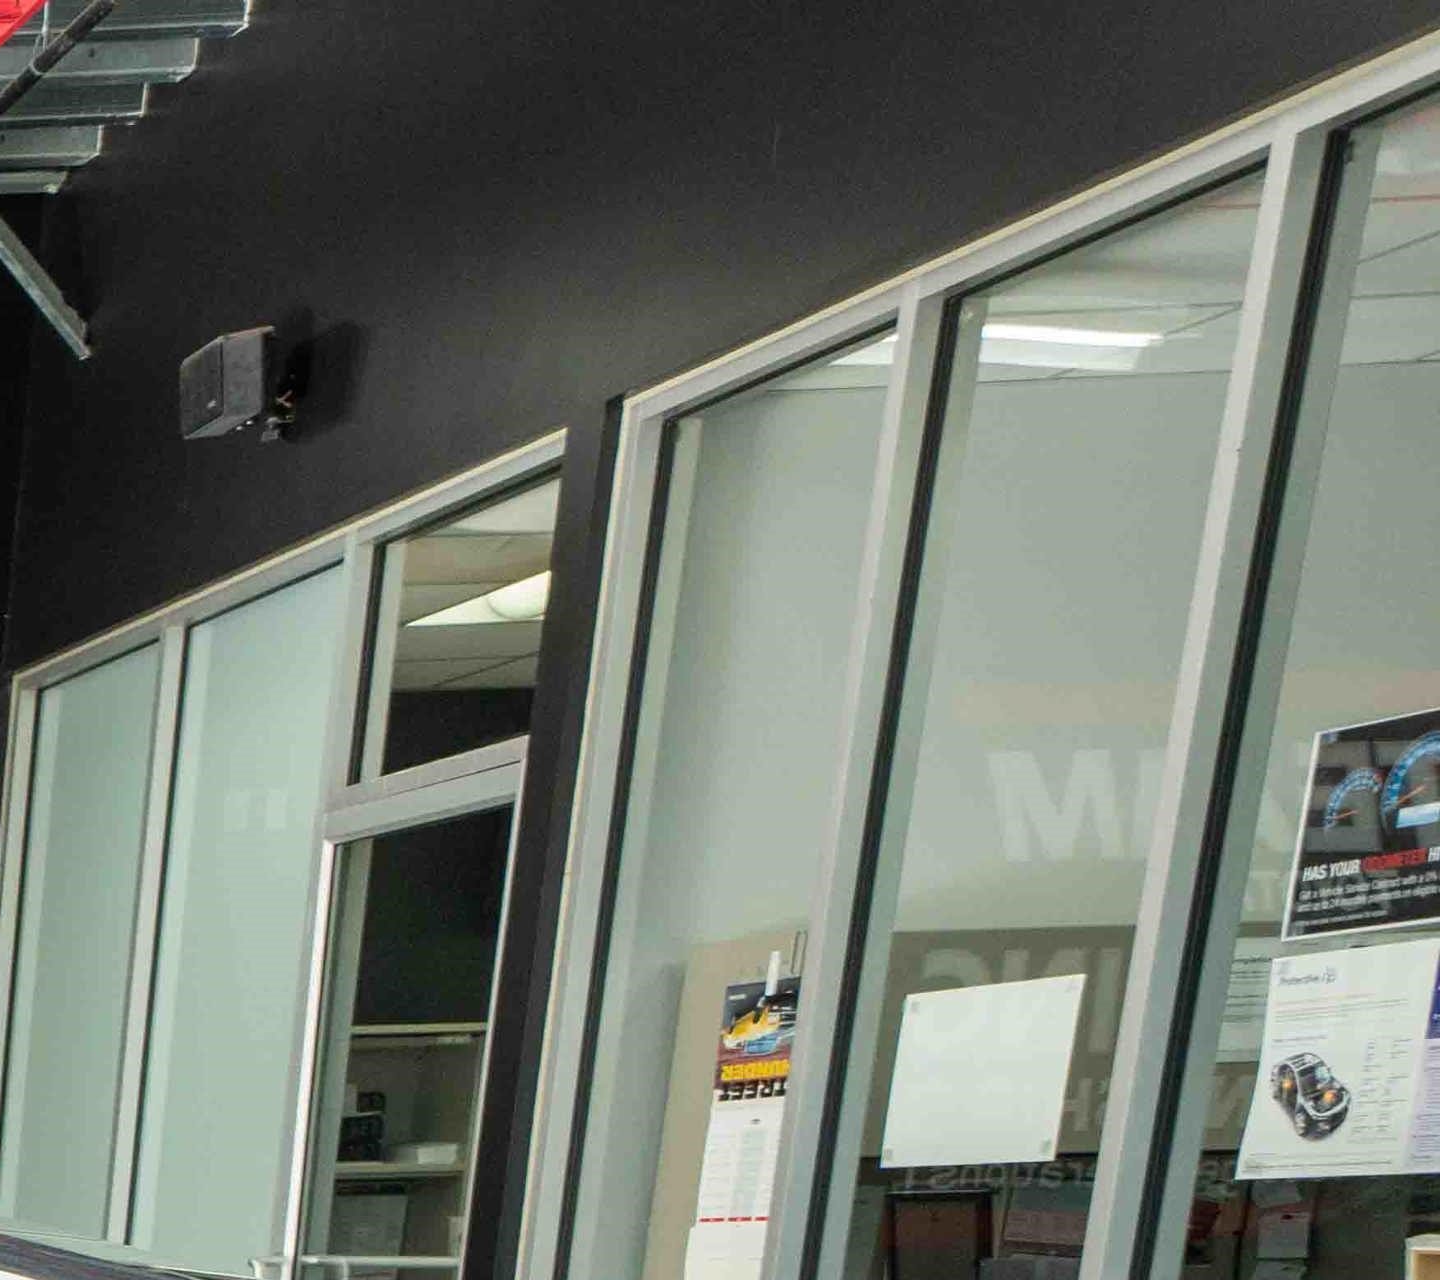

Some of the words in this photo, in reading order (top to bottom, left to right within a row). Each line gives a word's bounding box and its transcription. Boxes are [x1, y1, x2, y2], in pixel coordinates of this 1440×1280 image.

[1302, 864, 1327, 881] HAS
[1330, 859, 1360, 877] YOUR
[718, 1079, 787, 1101] TREET
